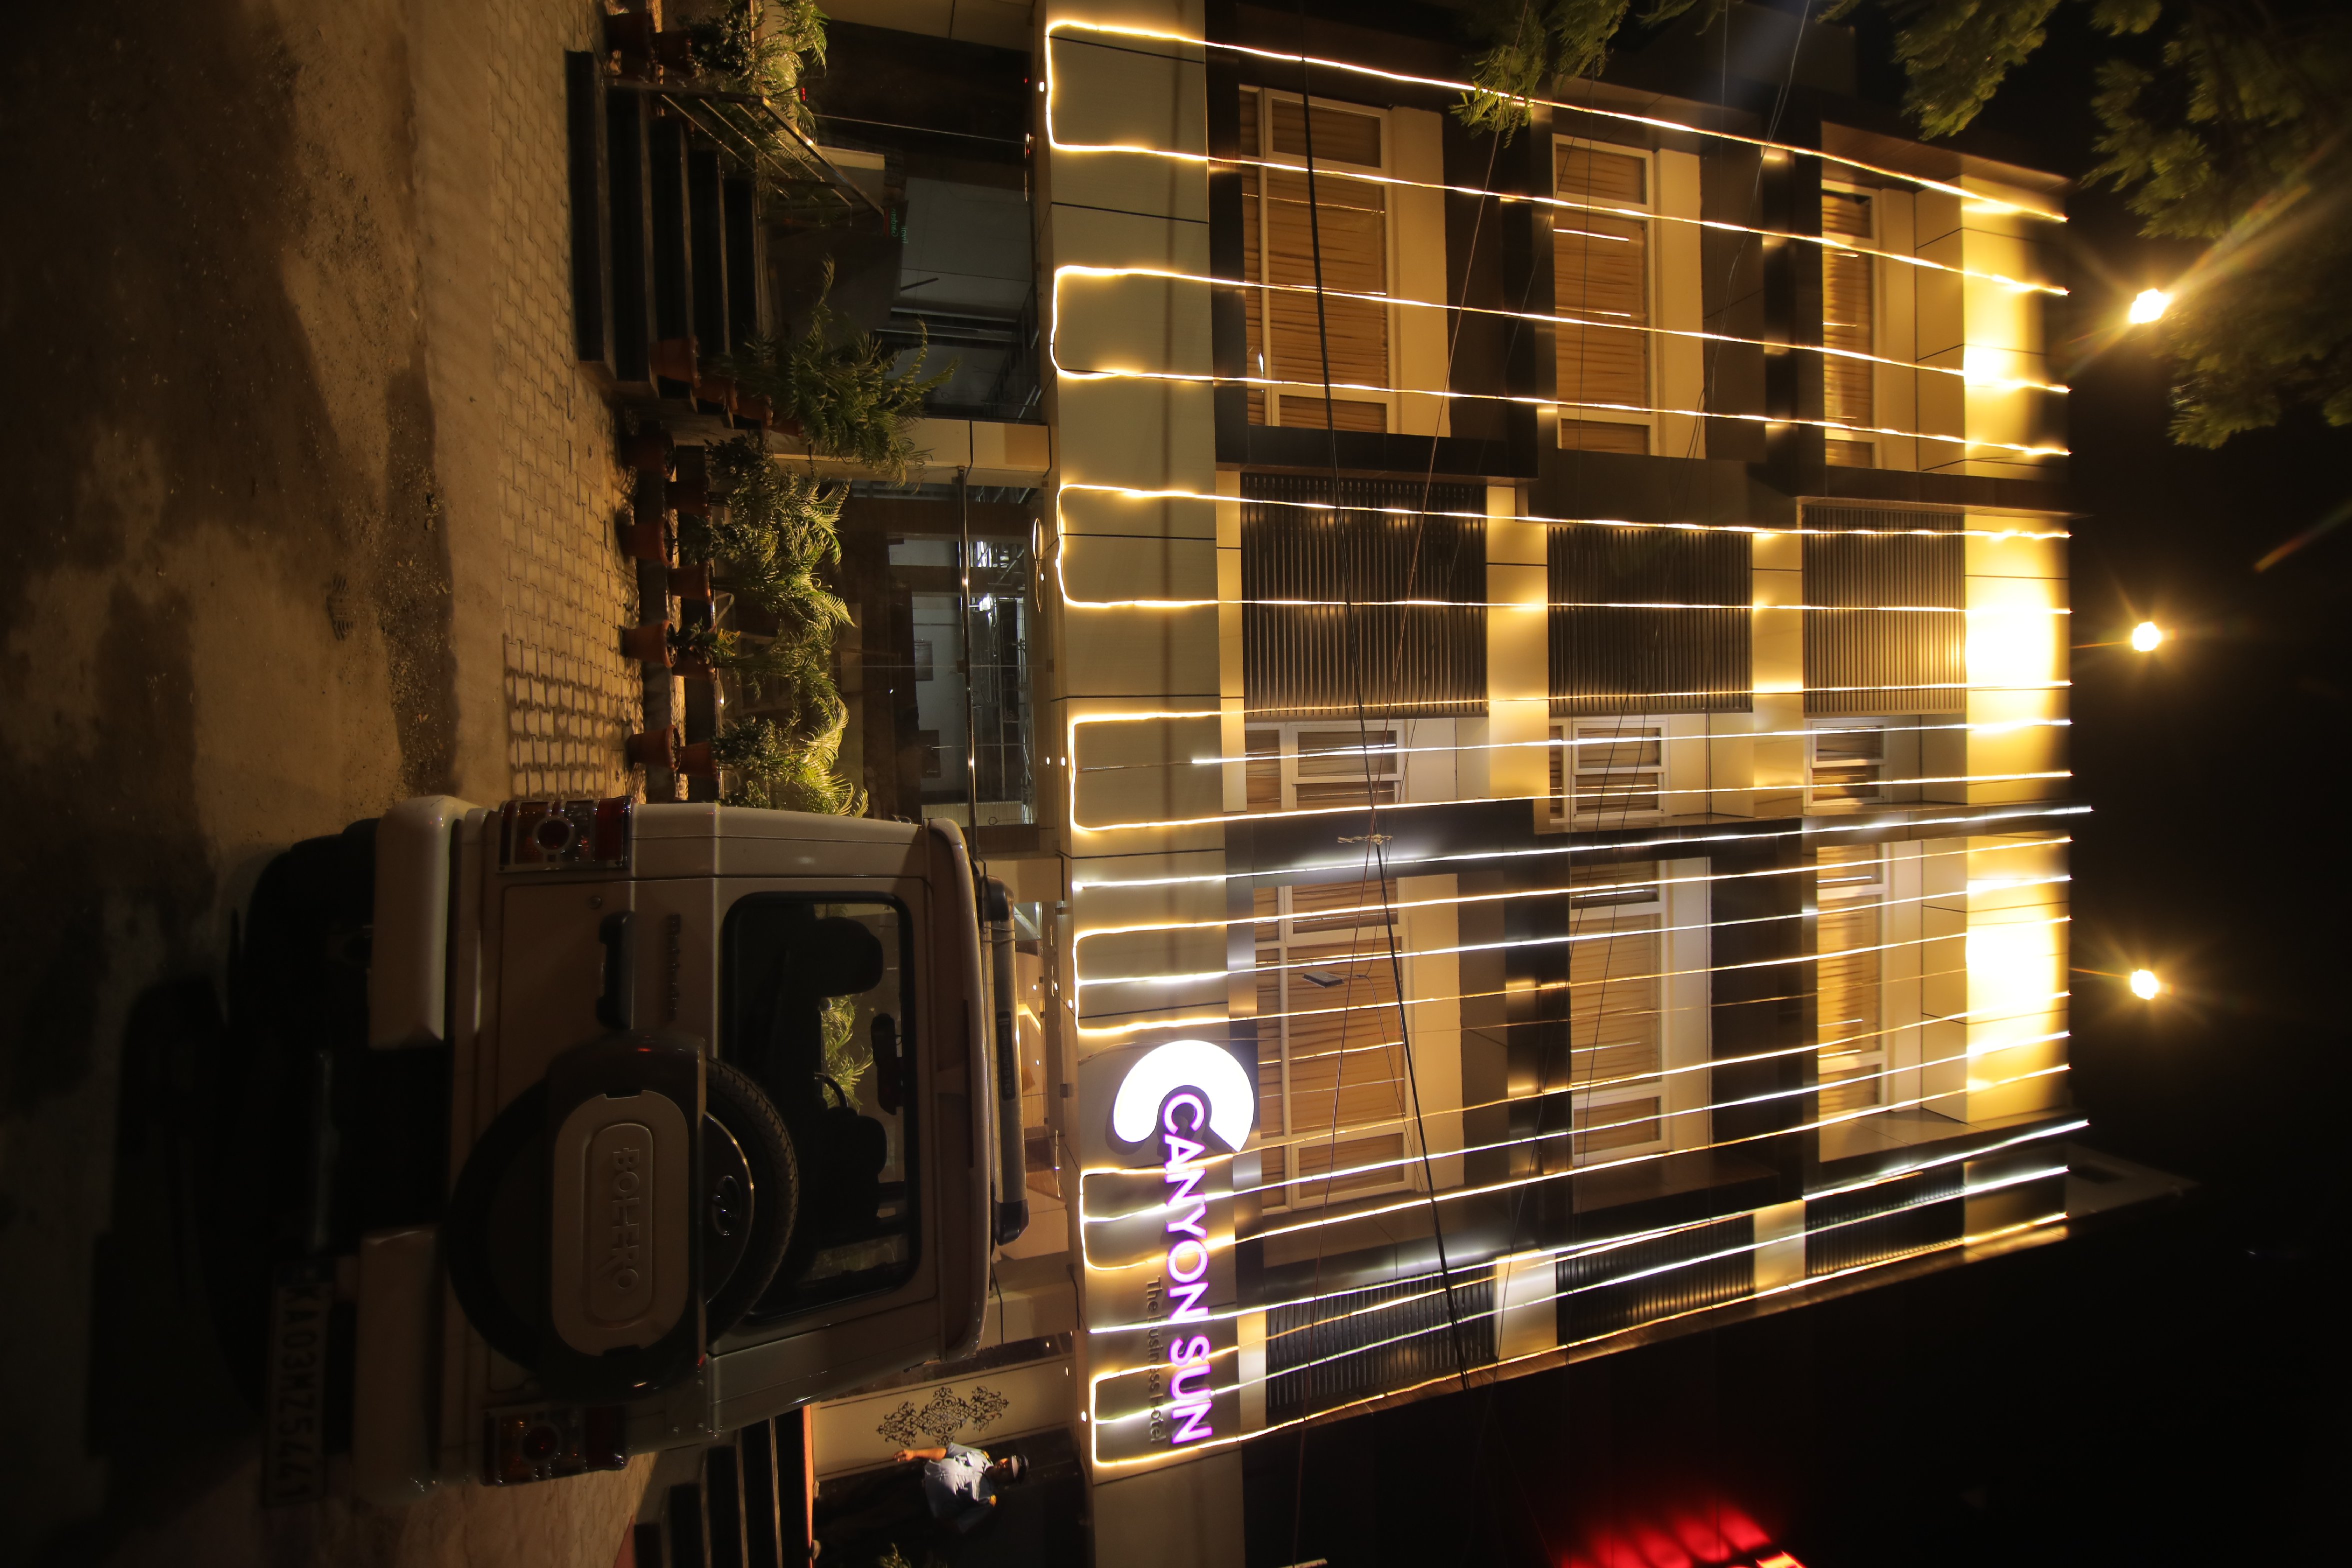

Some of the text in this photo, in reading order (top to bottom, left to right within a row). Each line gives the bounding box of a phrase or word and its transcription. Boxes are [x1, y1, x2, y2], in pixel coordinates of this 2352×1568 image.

[598, 1148, 645, 1295] BOLERO
[1163, 1094, 1213, 1444] CANYON SUN
[1146, 1276, 1167, 1444] The usiness Hotel
